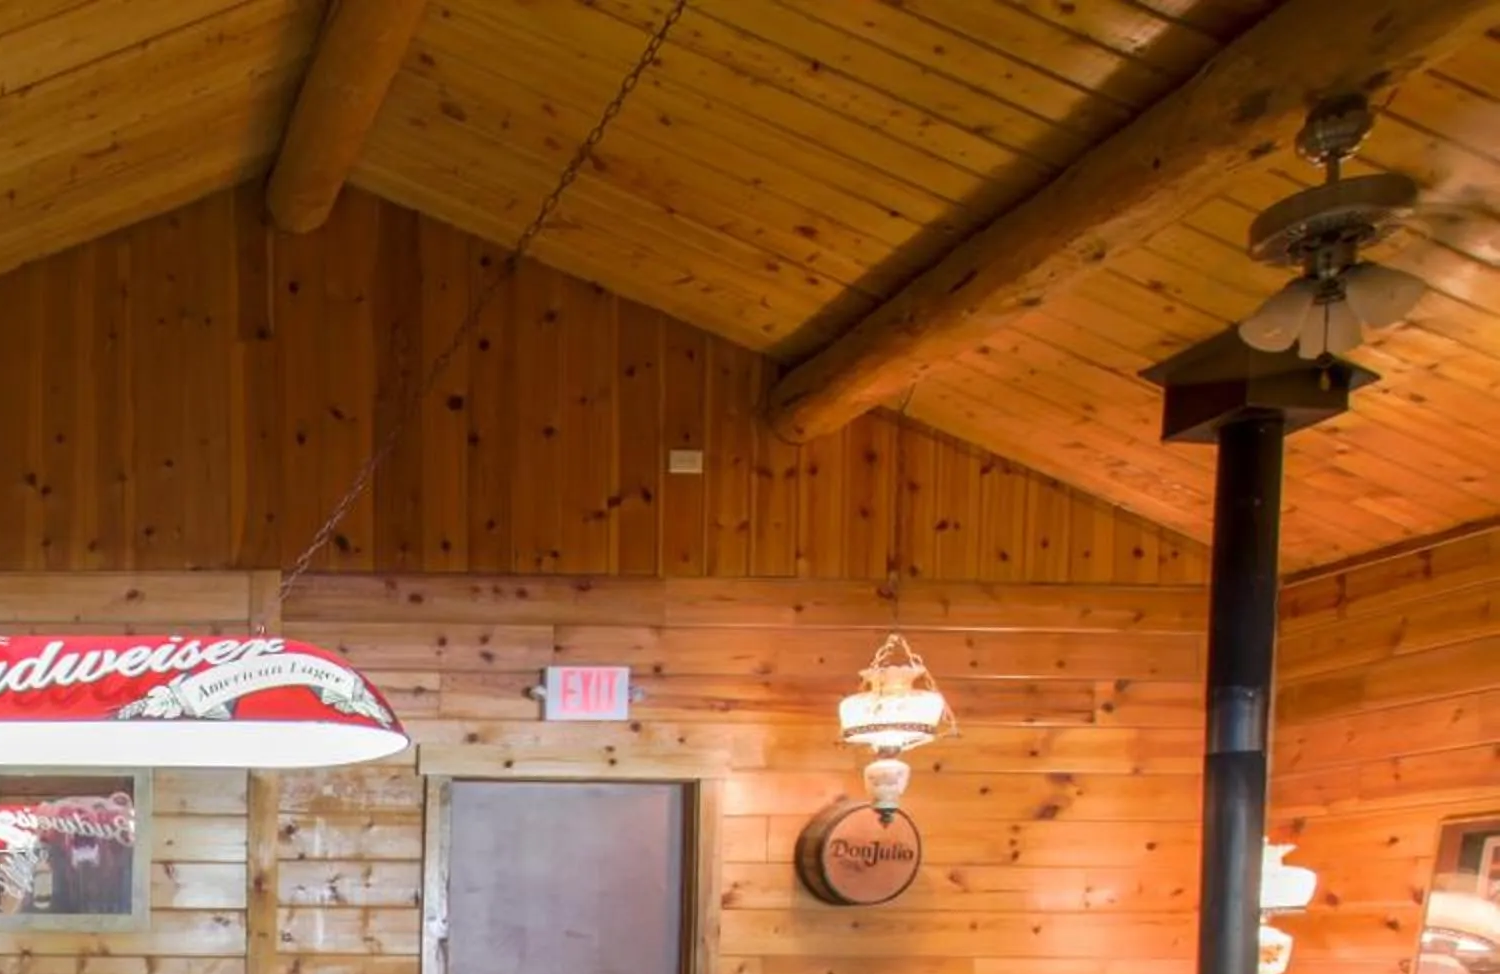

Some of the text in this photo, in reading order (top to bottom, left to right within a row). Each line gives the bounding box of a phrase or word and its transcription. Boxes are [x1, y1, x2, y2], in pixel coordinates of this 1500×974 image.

[199, 660, 349, 698] American Lager
[560, 668, 617, 713] EXIT
